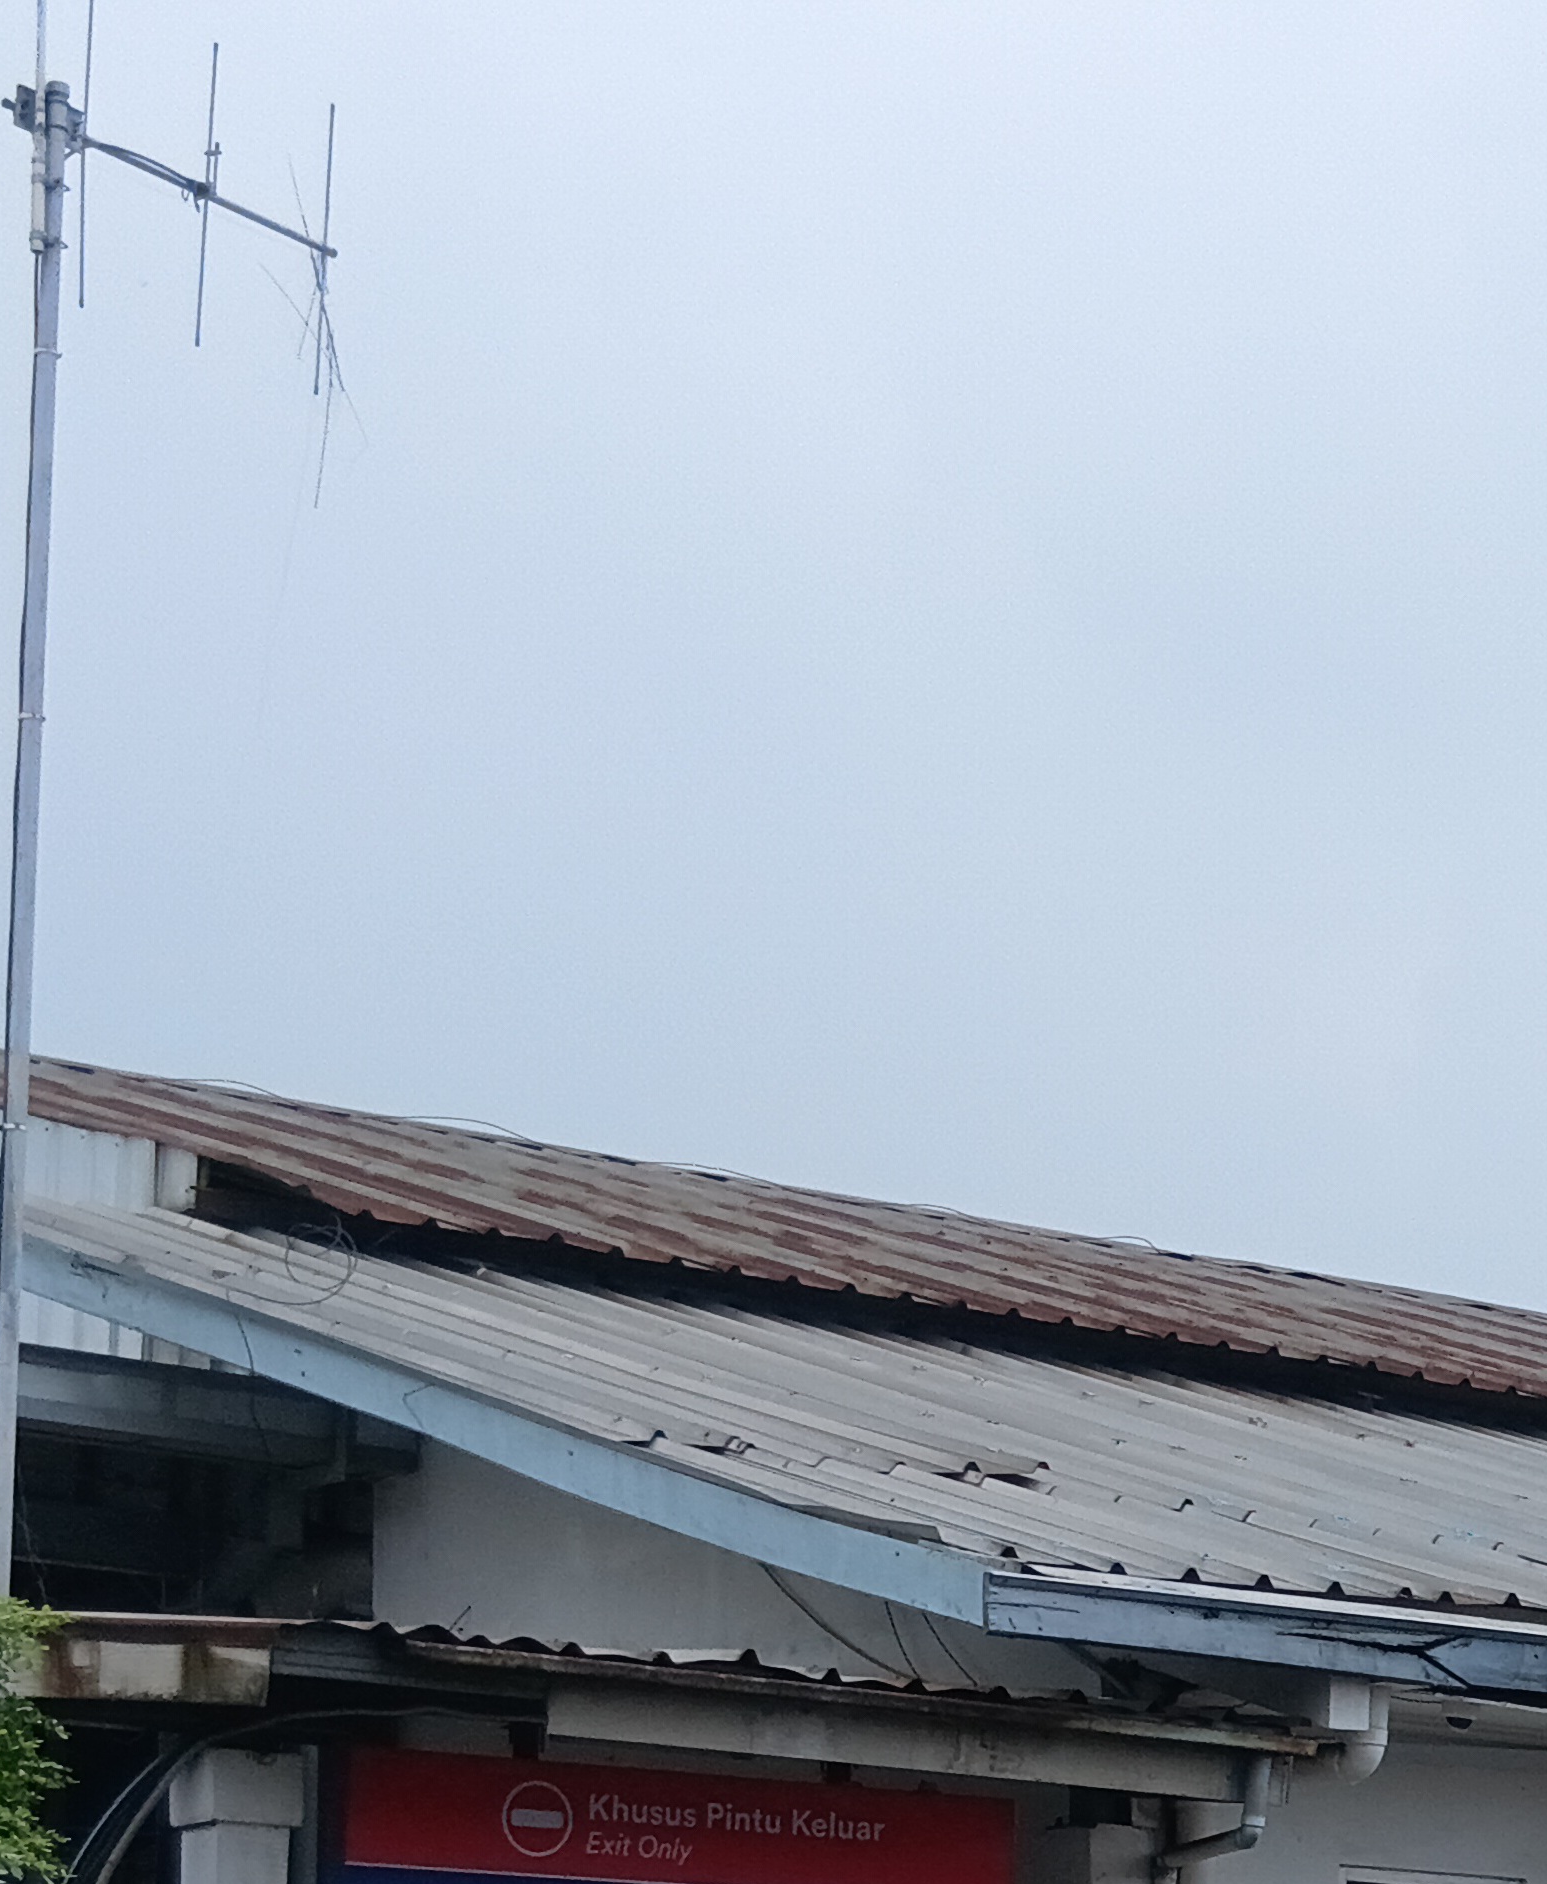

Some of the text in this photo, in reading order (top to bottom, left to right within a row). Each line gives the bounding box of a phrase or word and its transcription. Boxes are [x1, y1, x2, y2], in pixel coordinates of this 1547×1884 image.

[589, 1793, 885, 1841] Khusus Pintu Keluar
[585, 1831, 693, 1865] Exit Only
